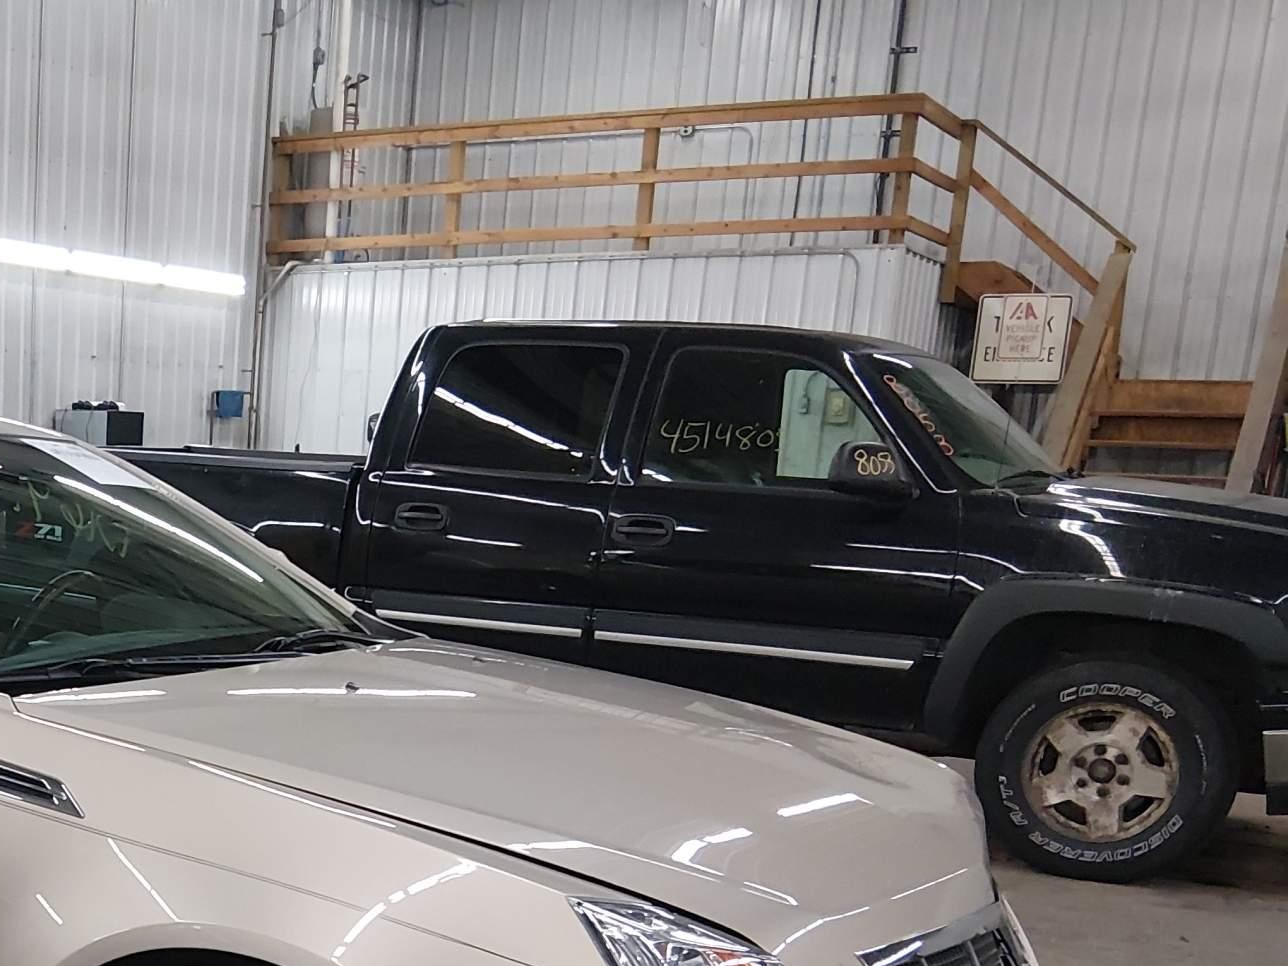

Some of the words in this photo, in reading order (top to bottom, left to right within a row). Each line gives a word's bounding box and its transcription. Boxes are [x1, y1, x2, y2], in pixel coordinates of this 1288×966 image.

[661, 419, 782, 453] 451480
[14, 521, 62, 538] Z71
[1060, 683, 1176, 719] COOPER
[1029, 815, 1184, 863] DISCOVERER
